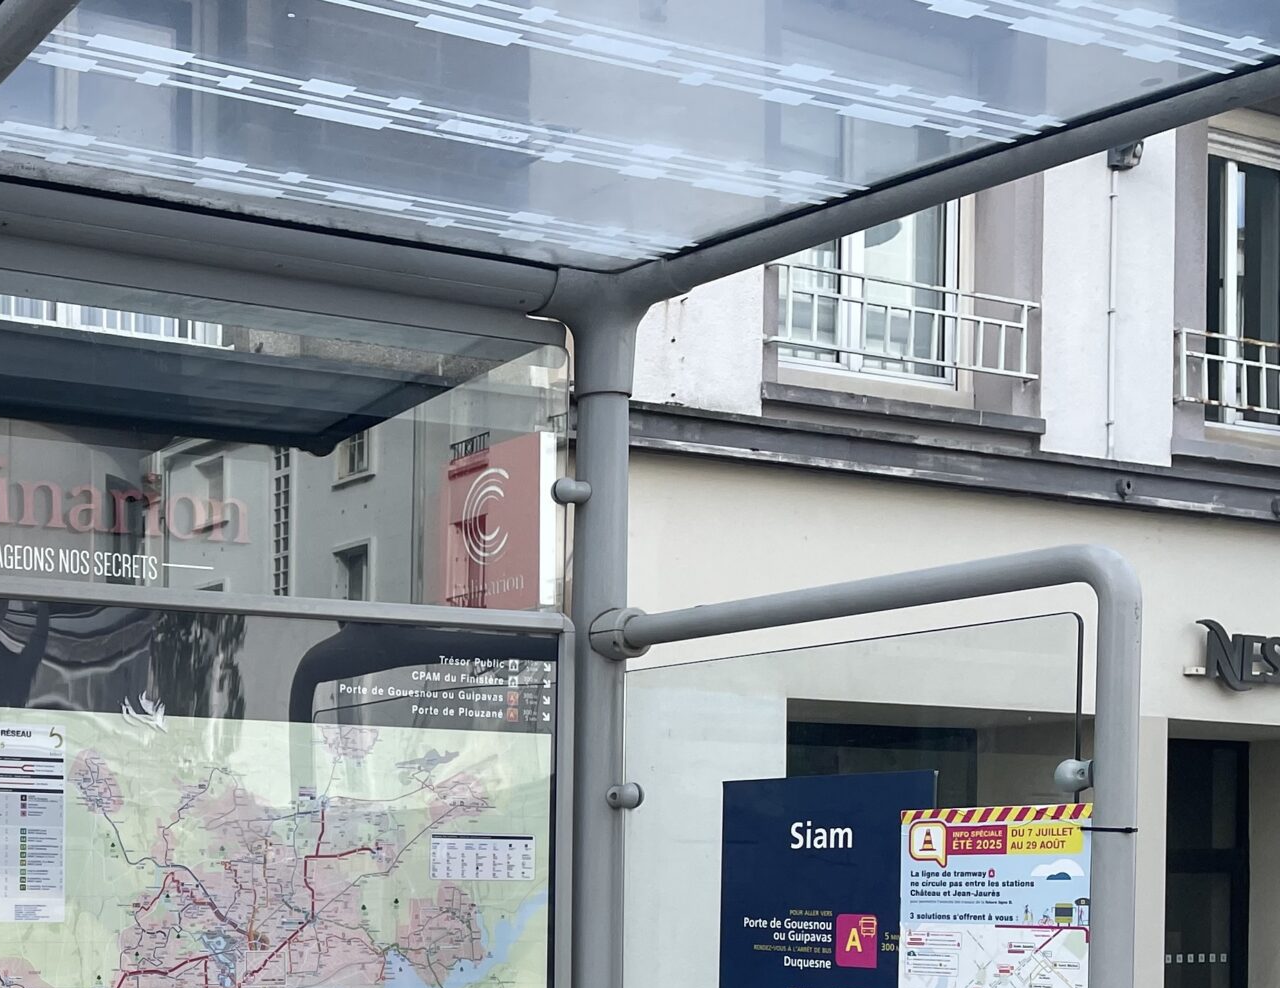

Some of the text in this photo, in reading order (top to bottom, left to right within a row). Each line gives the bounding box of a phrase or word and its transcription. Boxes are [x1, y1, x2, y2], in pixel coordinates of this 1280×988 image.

[60, 549, 89, 575] NOS
[94, 551, 157, 579] SECRETS
[440, 655, 504, 668] Trésor Public
[412, 672, 503, 685] CPAM du Finistère
[340, 684, 503, 702] Porte de Gouesnou ou Guipavas
[412, 706, 503, 718] Porte de Plouzané
[1, 728, 31, 738] RÉSEAU
[791, 821, 853, 849] Siam
[1012, 829, 1024, 837] DU
[1035, 827, 1073, 836] JUILLET
[953, 839, 1002, 850] ÉTÉ 2025
[1026, 841, 1037, 849] 29
[1040, 840, 1065, 849] AOÛT
[744, 917, 832, 930] Porte de Gouesnou
[788, 932, 832, 943] Guipavas
[845, 928, 862, 952] A
[784, 956, 831, 970] Duquesne
